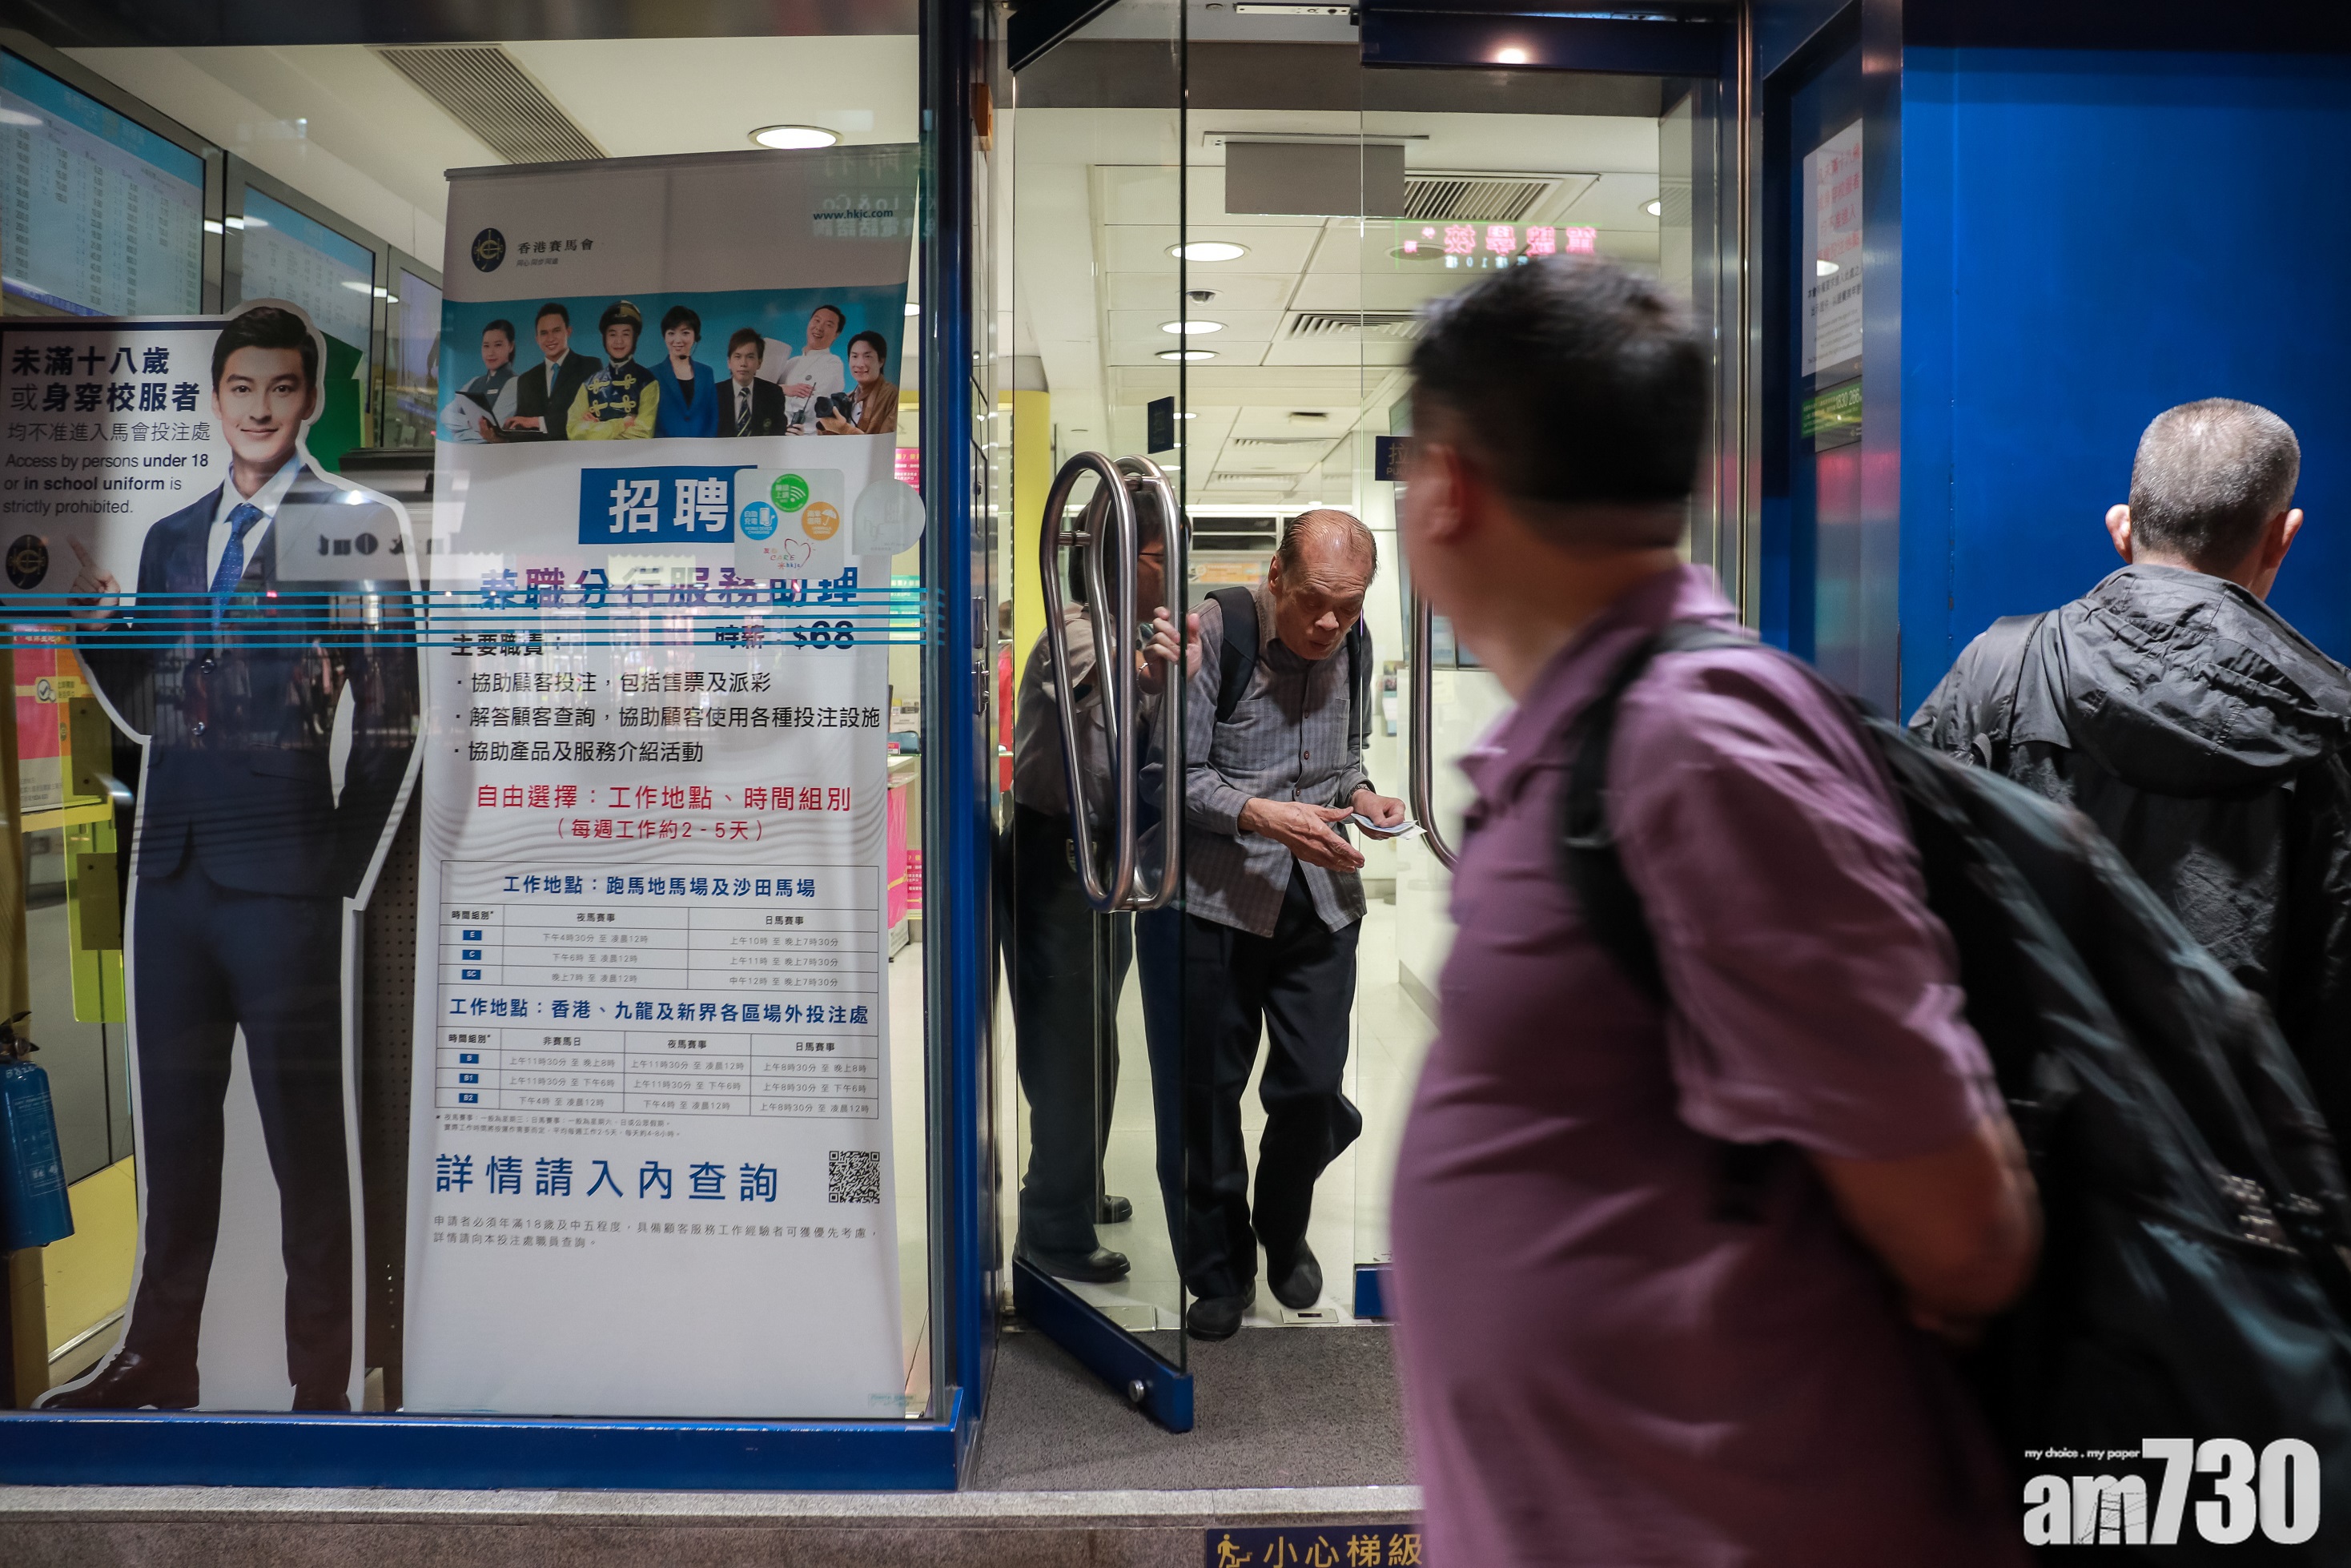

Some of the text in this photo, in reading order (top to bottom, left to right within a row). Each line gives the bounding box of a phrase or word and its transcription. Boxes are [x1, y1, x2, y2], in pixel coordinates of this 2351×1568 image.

[813, 208, 894, 220] www.hkjc.com
[517, 238, 593, 255] 香港賽馬會
[11, 345, 170, 376] 未滿十八歲
[10, 381, 200, 412] 或身穿校服者
[7, 421, 211, 442] 均不准進入馬會投注處
[5, 454, 208, 470] Access by persons under 18
[4, 476, 182, 490] or in school uniform is
[3, 500, 134, 516] strictly prohibited.
[609, 477, 729, 533] 招聘
[480, 566, 858, 609] 兼職分行服務助理
[793, 620, 855, 650] $68
[471, 671, 772, 694] 協助顧客投注，包括售票及派彩
[469, 706, 880, 729] 解答顧客查詢，協助顧客使用各種投注設施
[468, 741, 704, 763] 協助產品及服務介紹活動
[476, 784, 852, 812] 自由選擇：工作地點、時間組別
[503, 874, 817, 899] 工作地點：跑馬地馬場及沙田馬場
[577, 913, 615, 923] 夜馬賽事
[765, 915, 804, 926] 日馬賽事
[450, 998, 869, 1024] 工作地點：香港、九龍及新界各區場外投注處
[543, 1036, 581, 1046] 非賽馬日
[667, 1039, 707, 1049] 夜馬賽事
[795, 1042, 835, 1051] 日馬賽事
[436, 1153, 779, 1202] 詳情請入內查詢
[1263, 1533, 1423, 1568] 小心梯級
